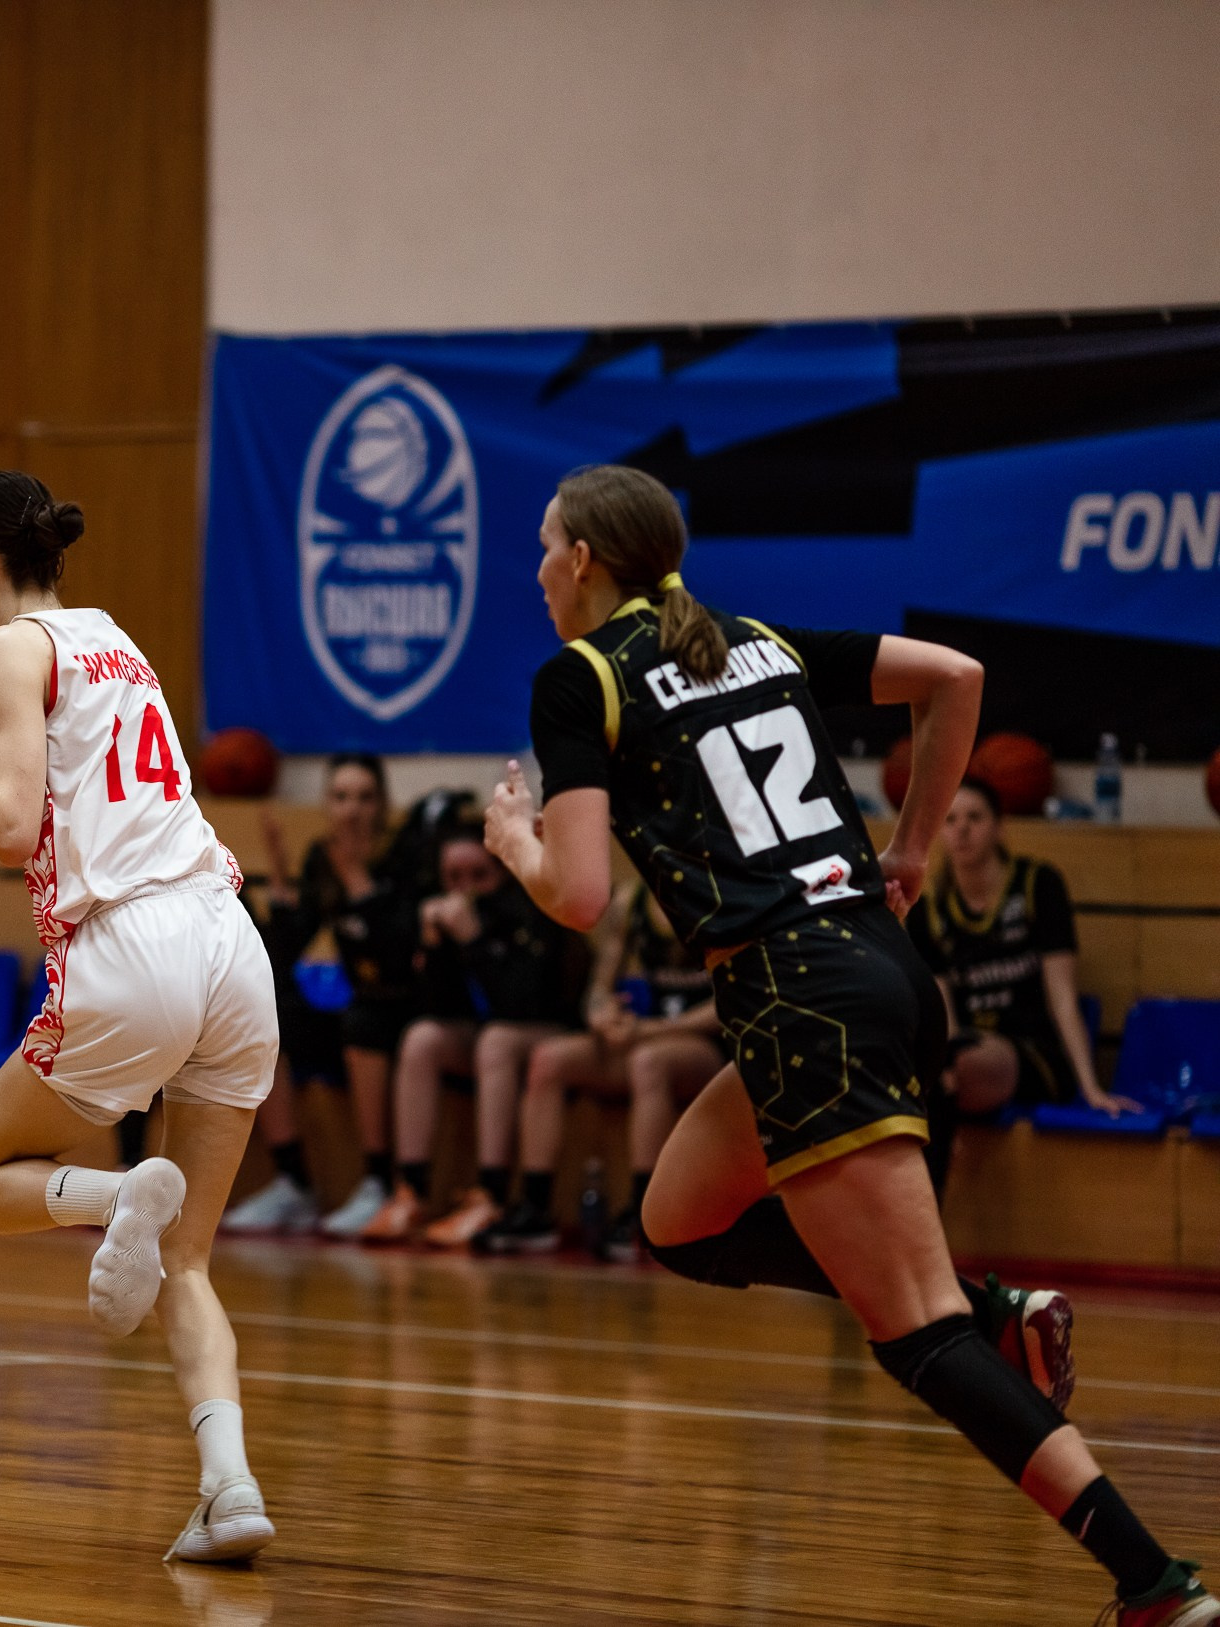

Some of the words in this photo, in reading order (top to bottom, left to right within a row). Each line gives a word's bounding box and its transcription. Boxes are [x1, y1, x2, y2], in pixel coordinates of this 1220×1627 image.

[1060, 491, 1220, 572] FON
[105, 702, 182, 803] 14
[696, 704, 844, 857] 12
